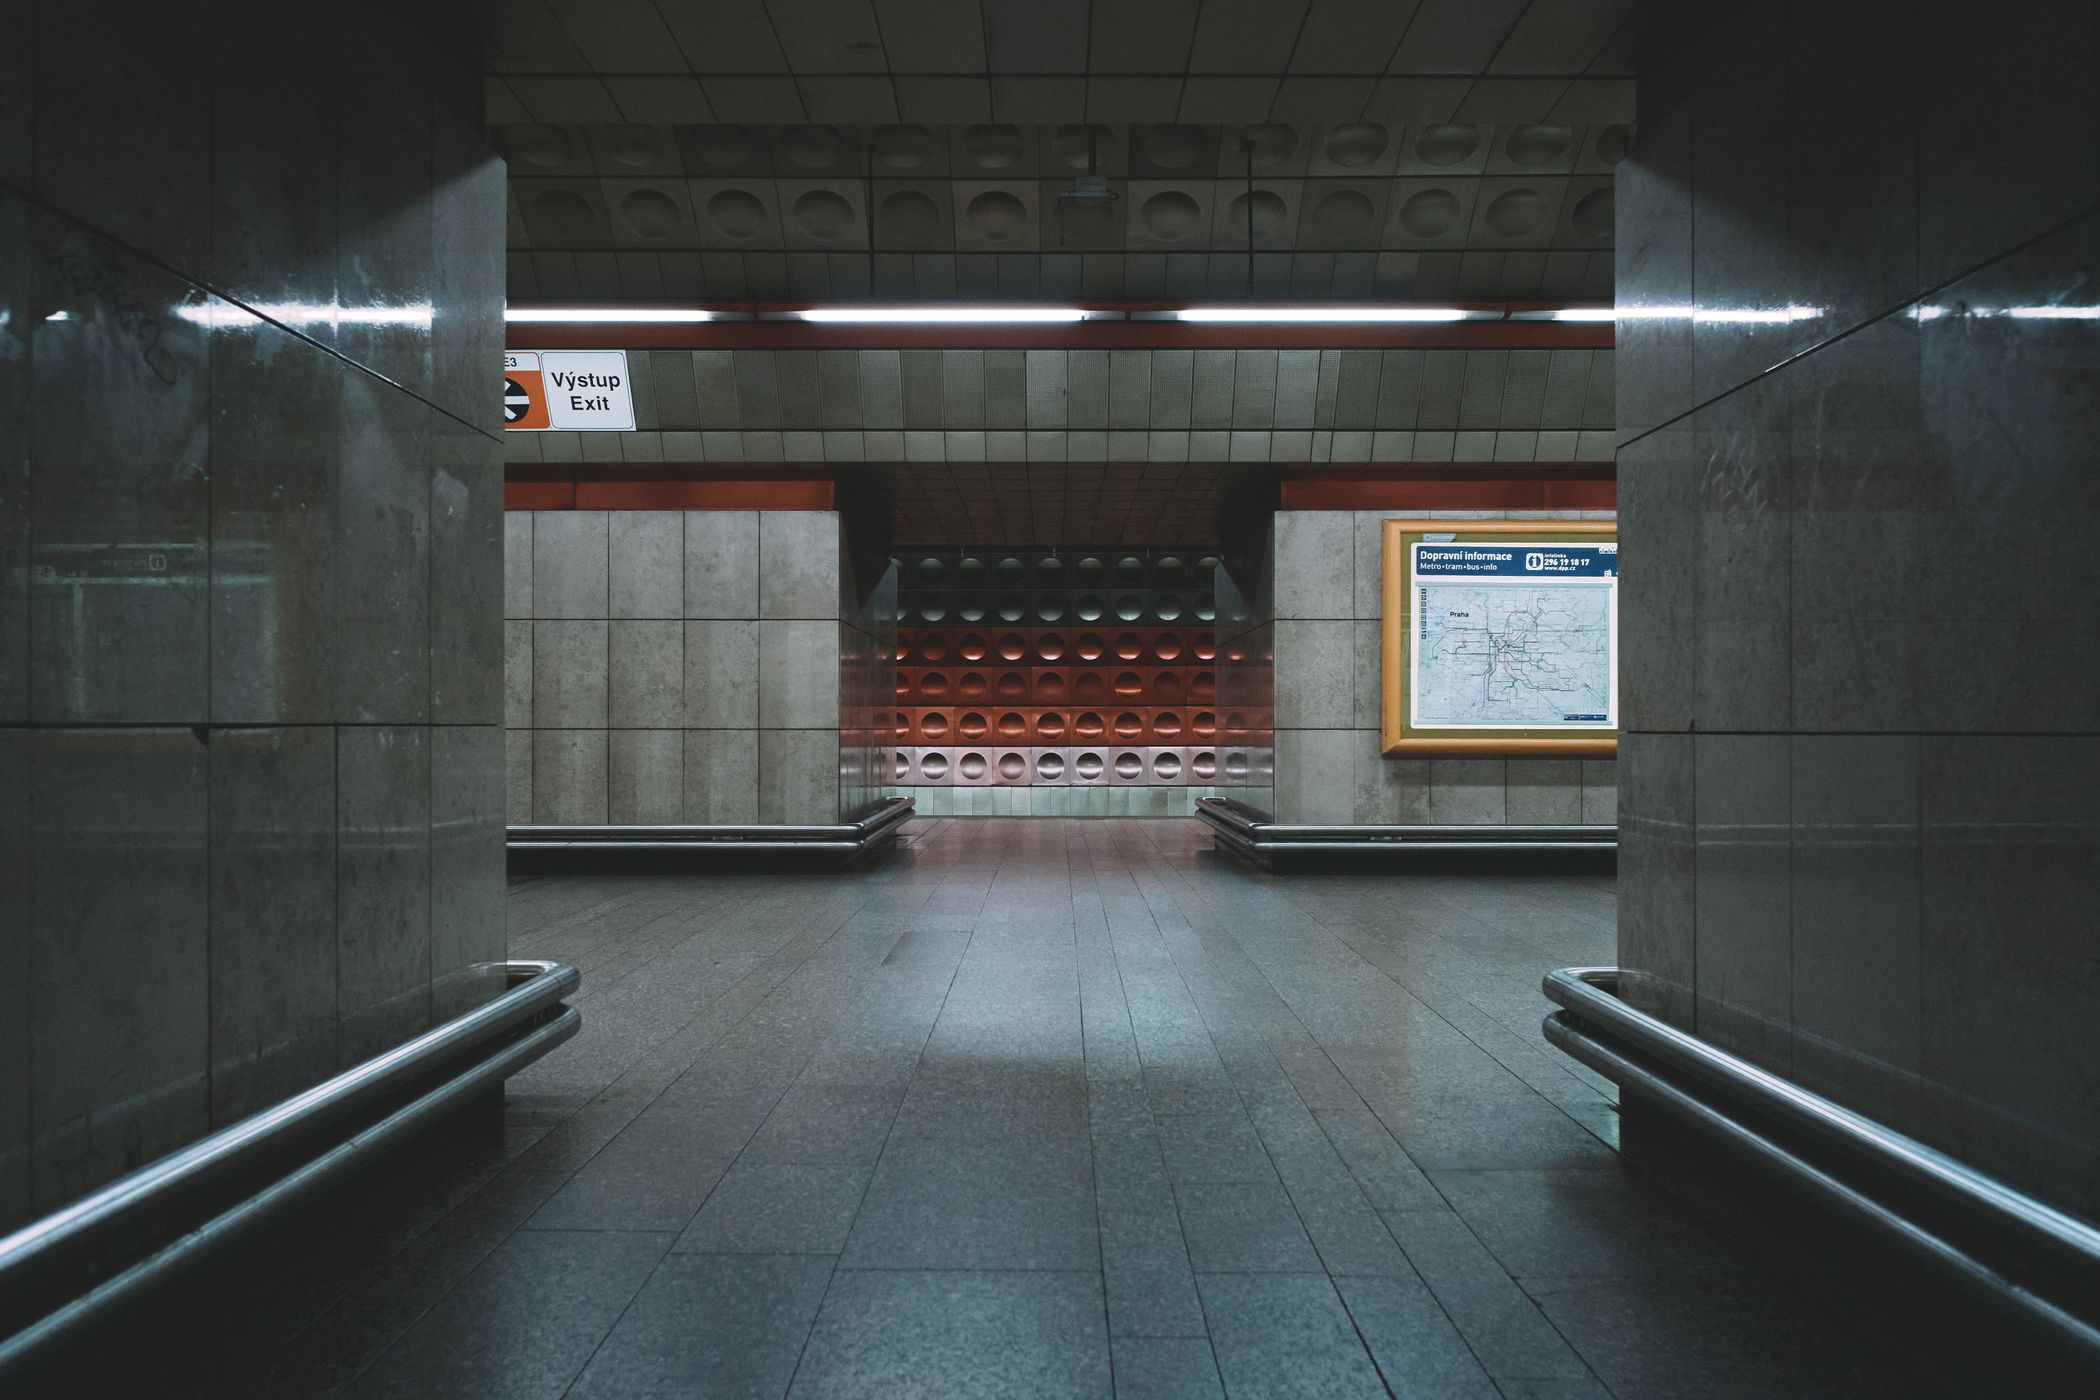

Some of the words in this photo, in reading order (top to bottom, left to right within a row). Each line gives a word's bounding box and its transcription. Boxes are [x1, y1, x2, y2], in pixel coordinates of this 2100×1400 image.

[551, 372, 620, 391] Výstup
[570, 395, 610, 411] Exit
[1420, 551, 1463, 561] Dopravní
[1465, 551, 1512, 560] informace
